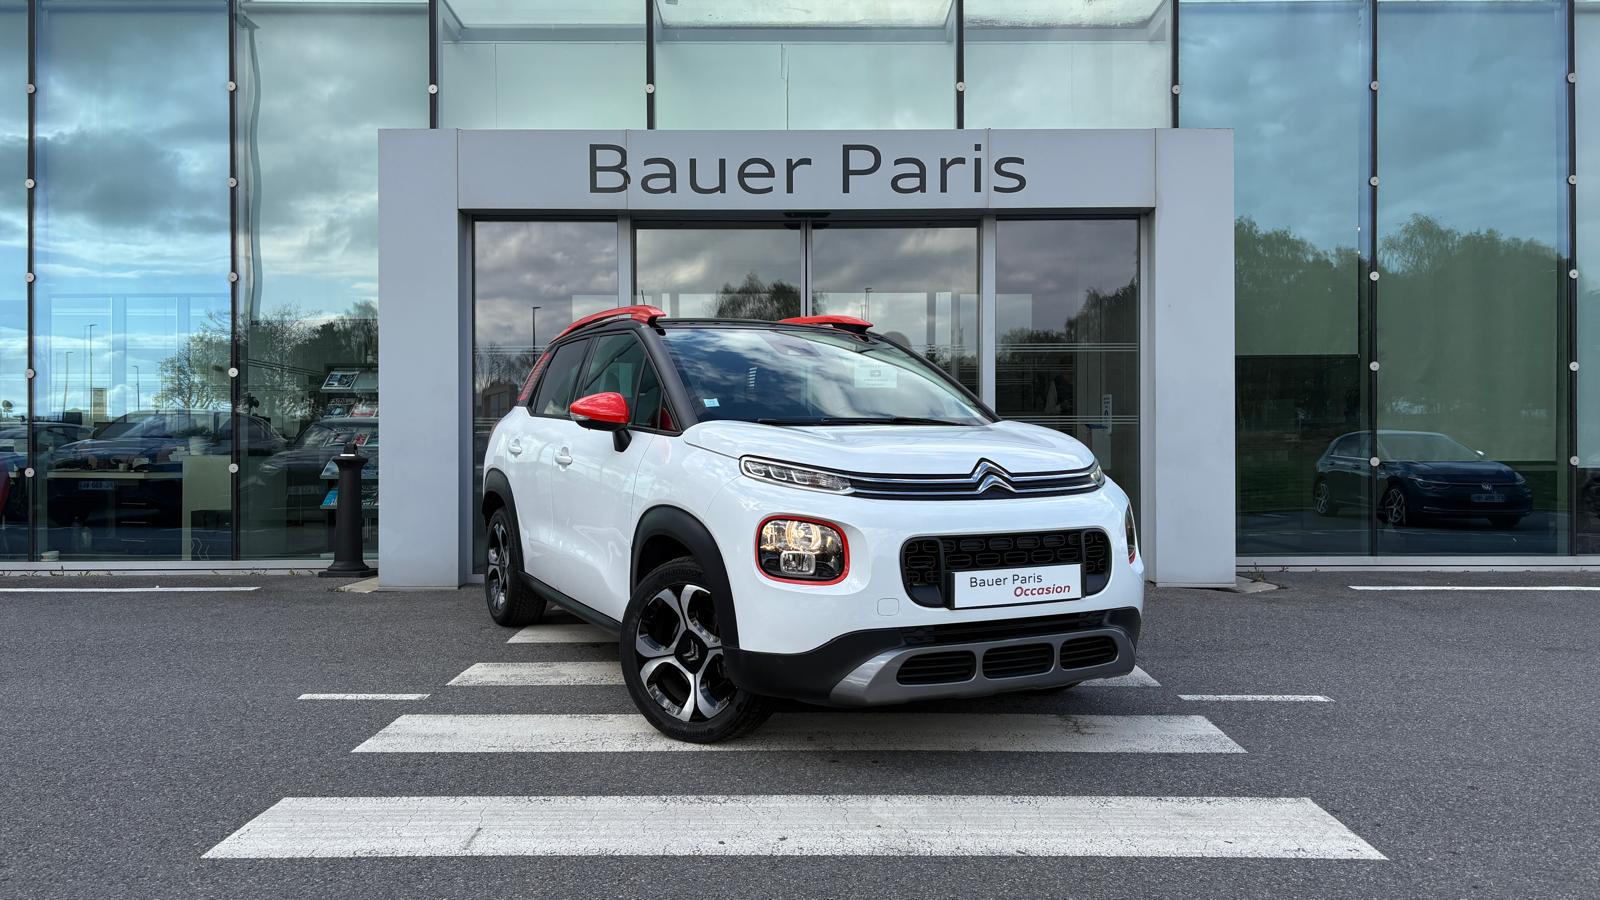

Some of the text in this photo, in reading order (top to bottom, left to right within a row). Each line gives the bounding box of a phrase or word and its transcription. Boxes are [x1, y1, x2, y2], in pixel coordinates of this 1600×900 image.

[589, 143, 1027, 195] Bauer Paris
[969, 573, 1043, 588] Bauer Paris
[1014, 583, 1071, 597] Occasion
